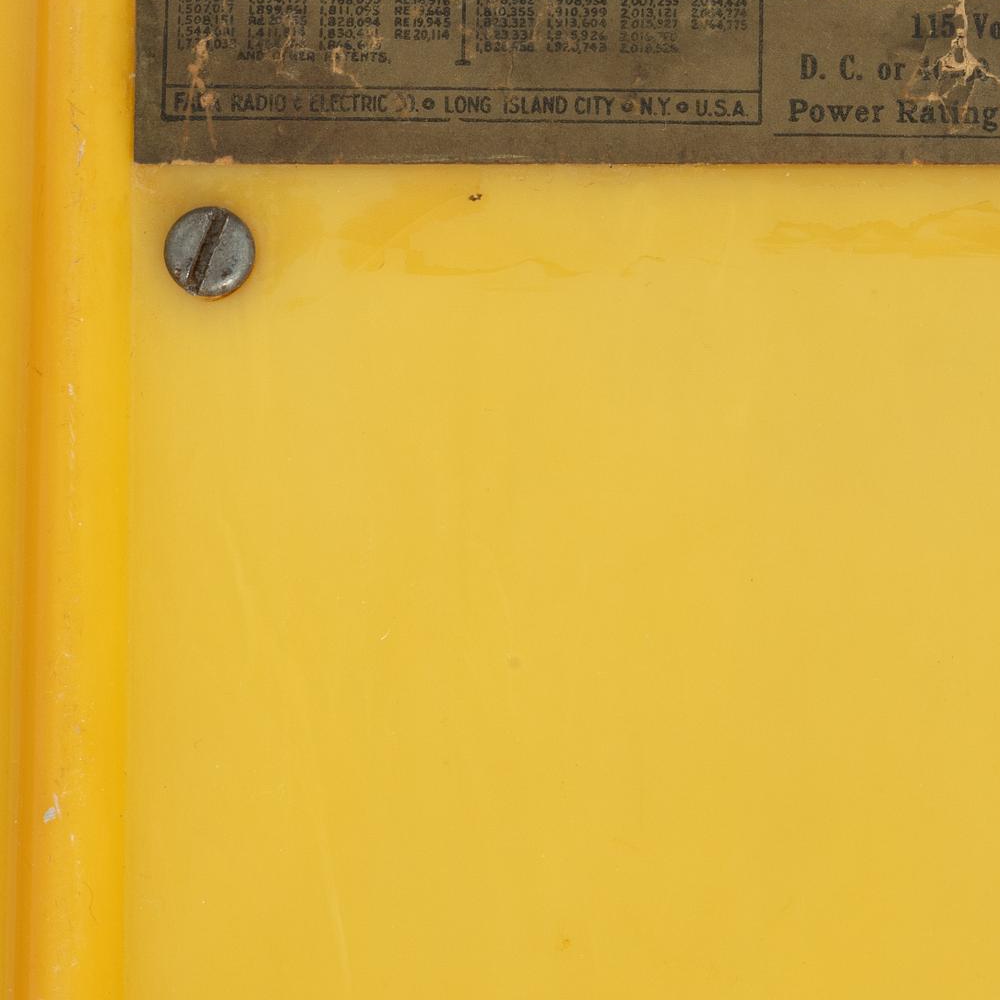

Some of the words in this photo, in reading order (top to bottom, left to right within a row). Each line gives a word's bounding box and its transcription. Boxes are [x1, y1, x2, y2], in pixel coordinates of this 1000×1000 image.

[912, 12, 956, 39] 115
[801, 53, 826, 79] D.
[840, 53, 862, 80] C.
[879, 60, 906, 80] or
[231, 93, 287, 114] RADIO
[310, 94, 388, 115] ELECTRIC
[444, 95, 492, 115] LONG
[503, 95, 568, 115] ISLAND
[574, 96, 616, 116] CITY
[640, 97, 671, 116] N.Y.
[696, 98, 749, 118] U.S.A.
[789, 98, 885, 123] Power
[896, 99, 1000, 131] Rating
